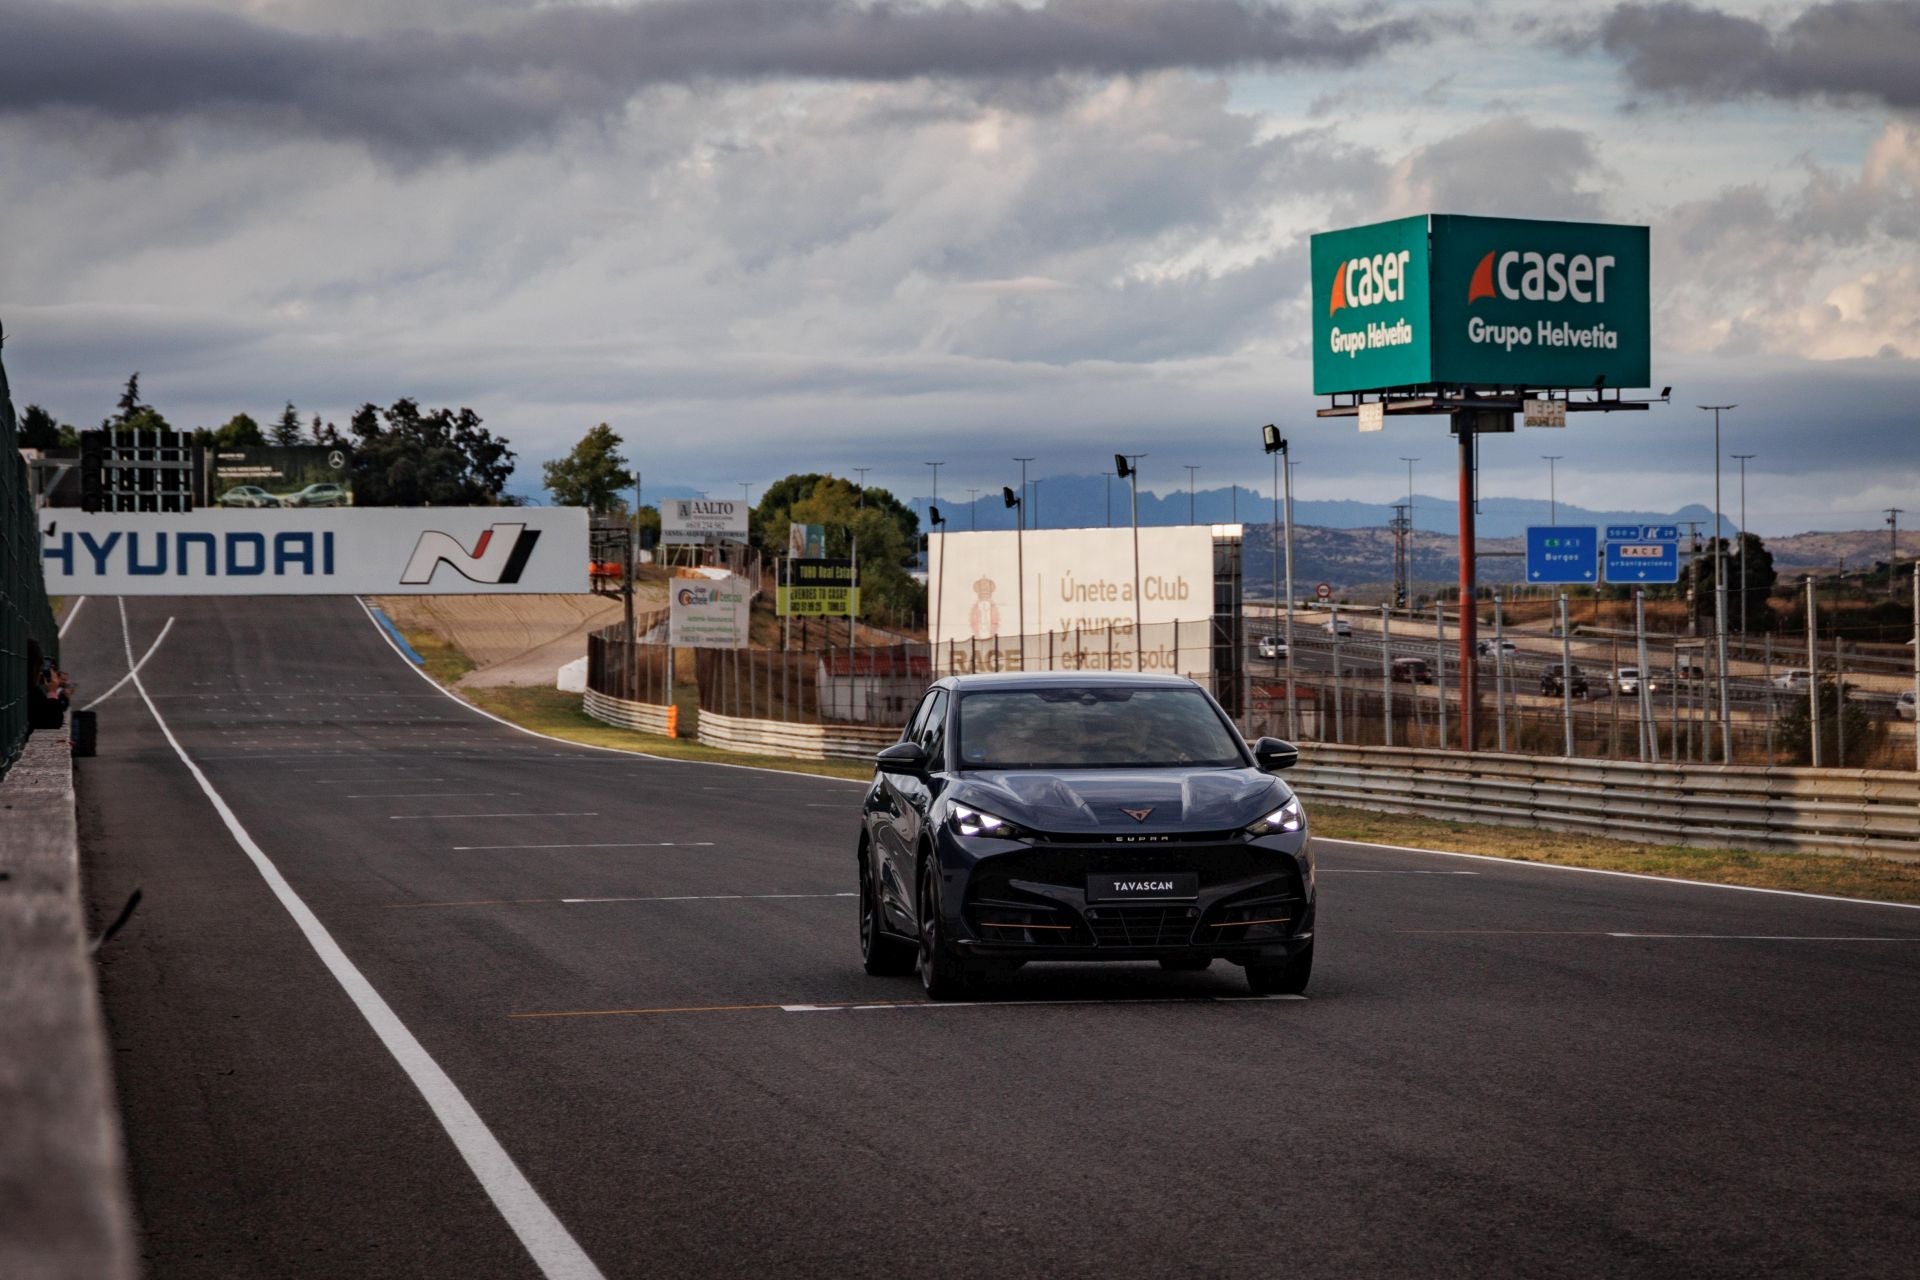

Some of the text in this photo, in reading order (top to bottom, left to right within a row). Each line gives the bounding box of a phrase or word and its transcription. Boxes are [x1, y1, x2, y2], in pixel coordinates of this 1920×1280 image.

[1345, 250, 1409, 308] caser
[1498, 251, 1615, 303] caser
[1330, 318, 1412, 358] Grupo Helvetia
[1468, 317, 1617, 352] Grupo Helvetia
[693, 502, 734, 515] AALTO
[43, 532, 333, 575] HYUNDAI
[1545, 553, 1579, 563] Burgos
[1061, 570, 1117, 602] Únete
[1144, 575, 1189, 600] Club
[1060, 615, 1133, 642] y nunca
[951, 649, 1023, 672] RACE
[1061, 641, 1133, 669] estarás
[1114, 881, 1172, 891] TAVASCAN
